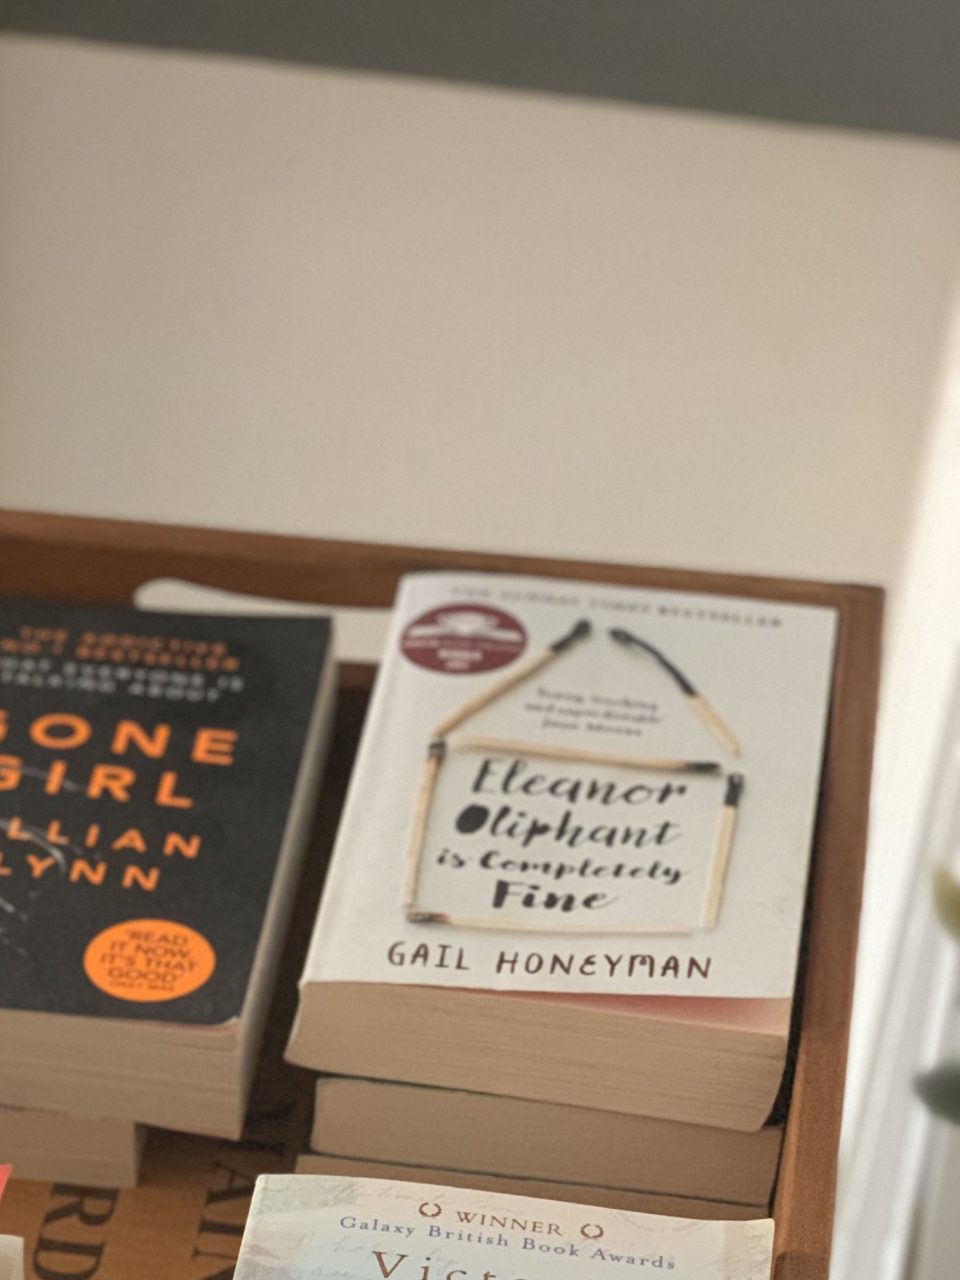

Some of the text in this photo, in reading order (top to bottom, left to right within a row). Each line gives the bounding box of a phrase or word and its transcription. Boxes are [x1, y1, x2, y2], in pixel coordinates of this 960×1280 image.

[471, 756, 688, 805] Eleanor
[454, 803, 682, 849] Oliphant
[437, 849, 689, 886] is Completely
[492, 879, 620, 912] Fine
[145, 957, 198, 972] THAT
[387, 941, 713, 980] GAIL HONEYMAN
[339, 1215, 677, 1272] Galaxy British Book Awards
[455, 1210, 565, 1239] WINNER
